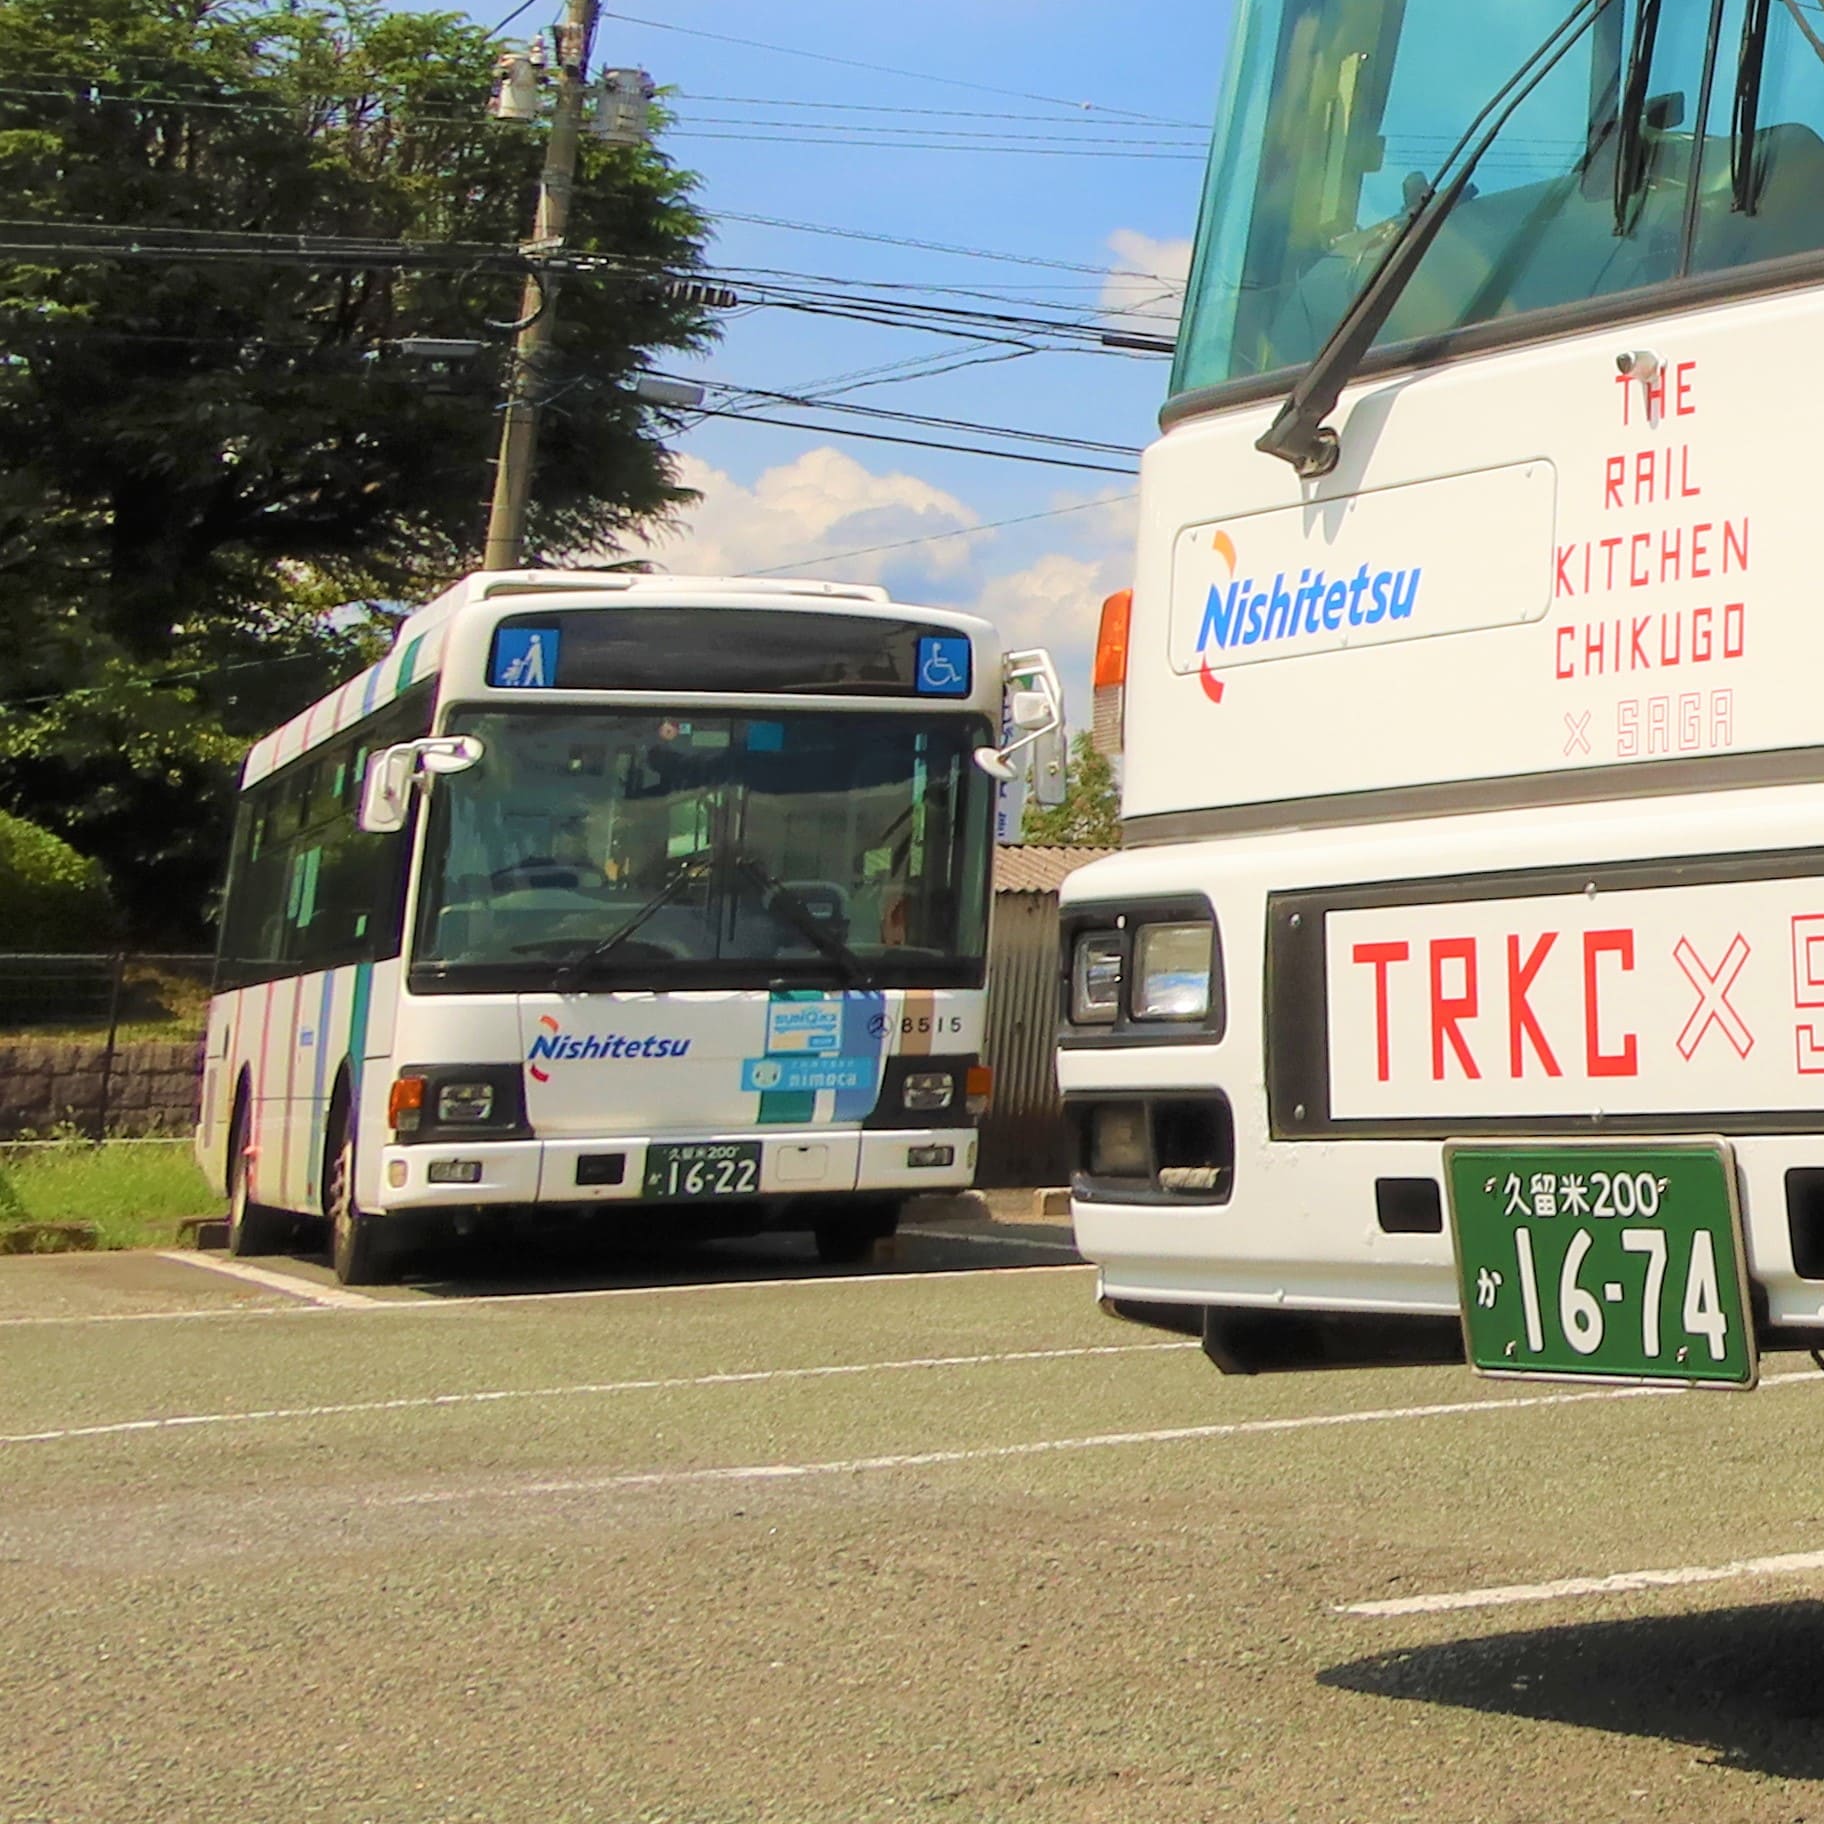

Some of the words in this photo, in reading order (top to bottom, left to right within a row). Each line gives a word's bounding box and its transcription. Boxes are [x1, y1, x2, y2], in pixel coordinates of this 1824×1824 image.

[1615, 361, 1696, 426] THE
[1605, 444, 1700, 510] RAIL
[1556, 517, 1749, 598] KITCHEN
[1196, 562, 1422, 653] Nishitetsu
[1556, 603, 1745, 679] CHIKUGO
[1616, 688, 1734, 757] SAGA
[529, 1033, 692, 1060] Nishitetsu
[902, 1017, 961, 1034] 8515
[668, 1159, 758, 1196] 16-22
[1503, 1172, 1660, 1218] 久留米200
[1476, 1266, 1503, 1309] か
[1513, 1226, 1728, 1362] 16-74
